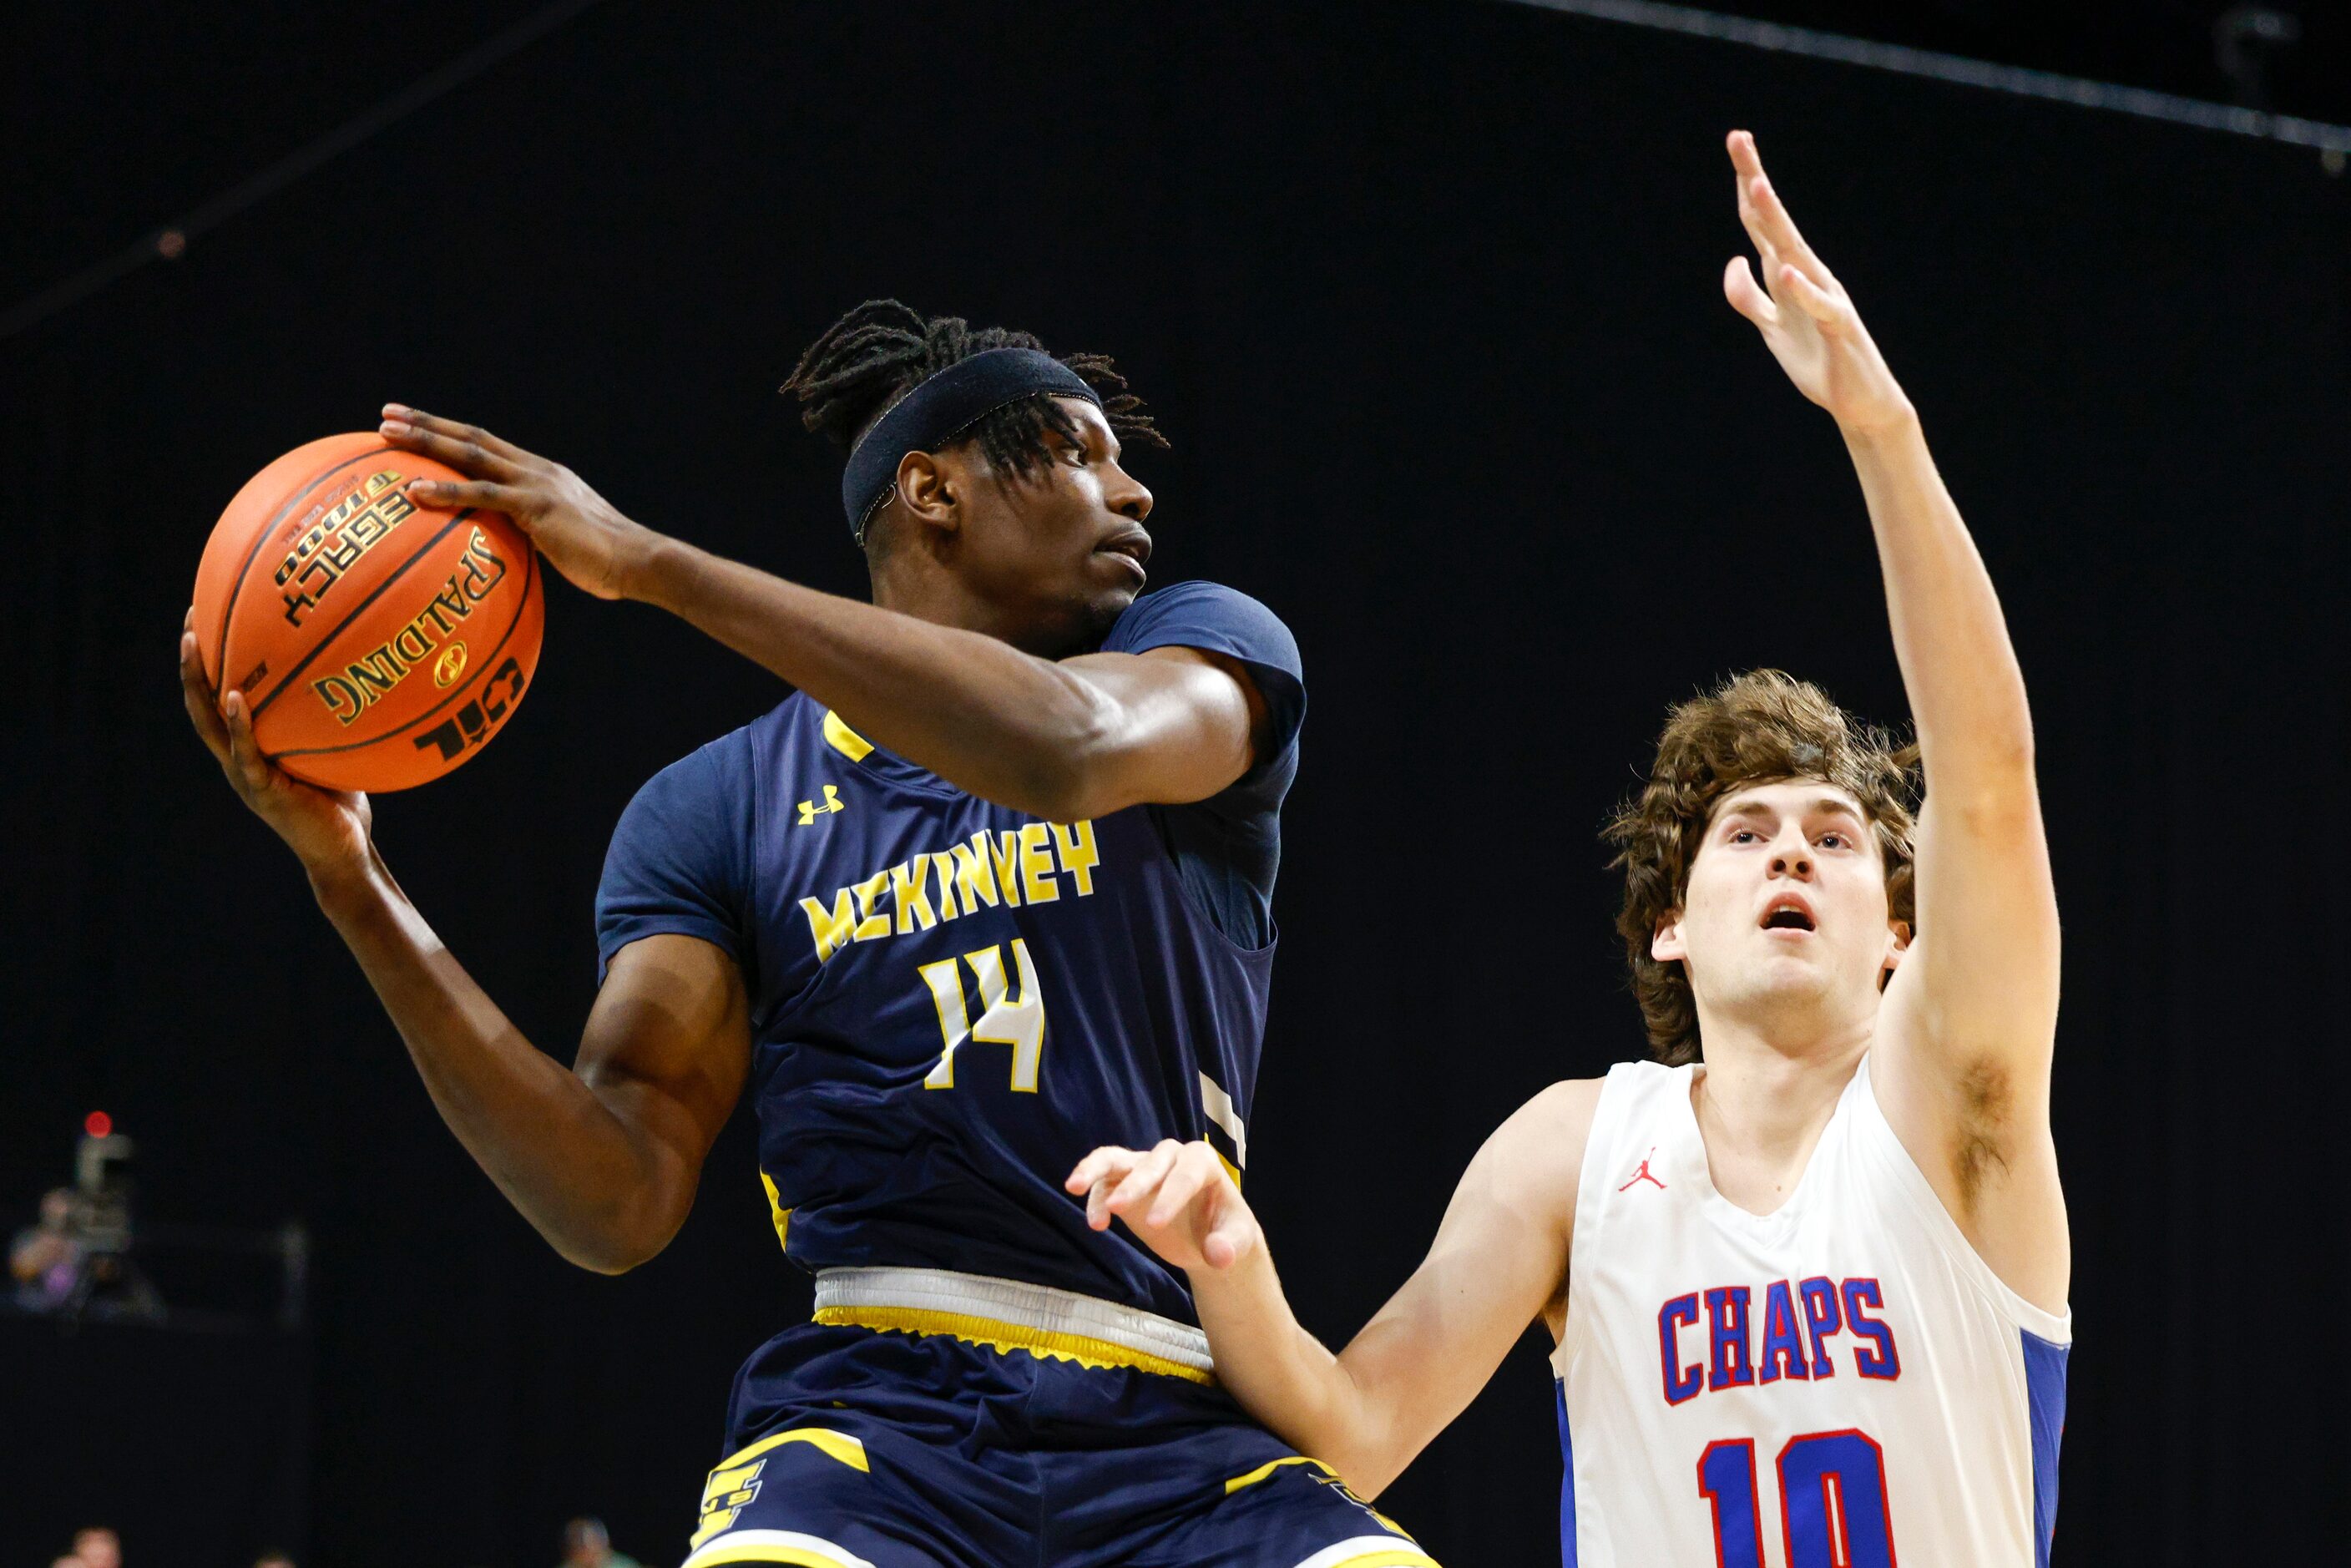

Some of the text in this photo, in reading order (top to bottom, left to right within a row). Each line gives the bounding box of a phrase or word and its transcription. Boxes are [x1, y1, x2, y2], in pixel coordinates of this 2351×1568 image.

[283, 476, 424, 628] EGACY
[312, 525, 507, 727] SPALDING
[918, 938, 1045, 1094] 14
[1657, 1276, 1902, 1407] CHAPS
[1696, 1427, 1898, 1568] 10
